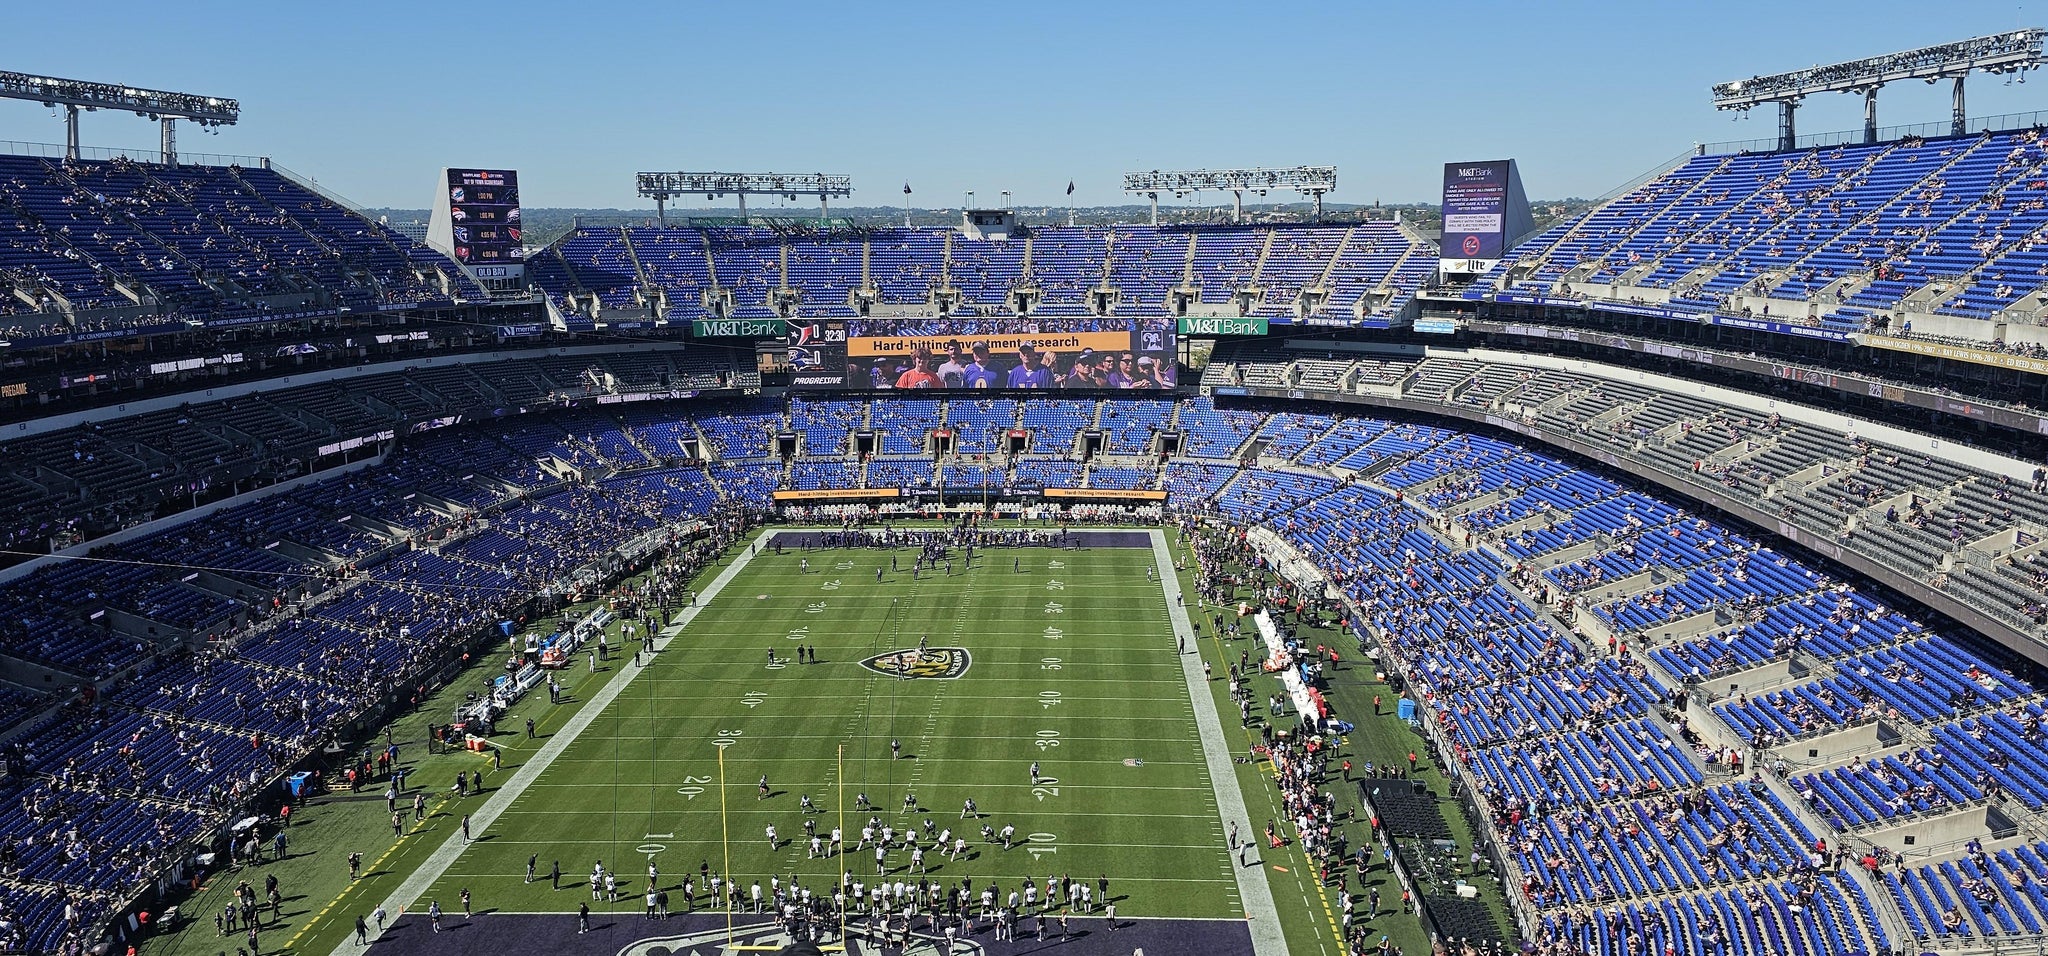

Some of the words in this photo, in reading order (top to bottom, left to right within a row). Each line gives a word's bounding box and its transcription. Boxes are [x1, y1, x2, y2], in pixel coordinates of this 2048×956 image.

[1458, 168, 1474, 177] M&T
[1475, 168, 1493, 176] Bank
[478, 268, 491, 276] OLD
[493, 268, 505, 276] BAY
[1467, 260, 1485, 272] Lite
[702, 321, 741, 336] M&T
[742, 321, 777, 335] Bank
[813, 324, 819, 339] 0
[1186, 319, 1223, 333] M&T
[1224, 319, 1259, 335] Bank
[825, 329, 845, 341] 32:30
[873, 340, 949, 351] Hard-hitting
[958, 338, 1021, 349] nvetment
[1872, 338, 1894, 346] JONATHAN
[1895, 340, 1910, 349] OGDEN
[1912, 343, 1935, 353] 1996-2007
[814, 351, 820, 365] 0
[1970, 352, 1997, 363] 1996-2012
[1, 383, 28, 397] PREGAME
[805, 603, 826, 613] 30
[1045, 604, 1063, 613] 30
[786, 629, 809, 639] 40
[1043, 629, 1062, 639] 40
[946, 651, 961, 675] RAVENS
[1041, 658, 1062, 670] 50
[740, 691, 768, 704] 40
[1038, 691, 1062, 705] 40
[711, 730, 742, 746] 30
[1035, 730, 1060, 746] 30
[677, 776, 712, 794] 20
[1032, 777, 1059, 796] 20
[636, 832, 674, 853] 10
[1027, 833, 1056, 854] 10
